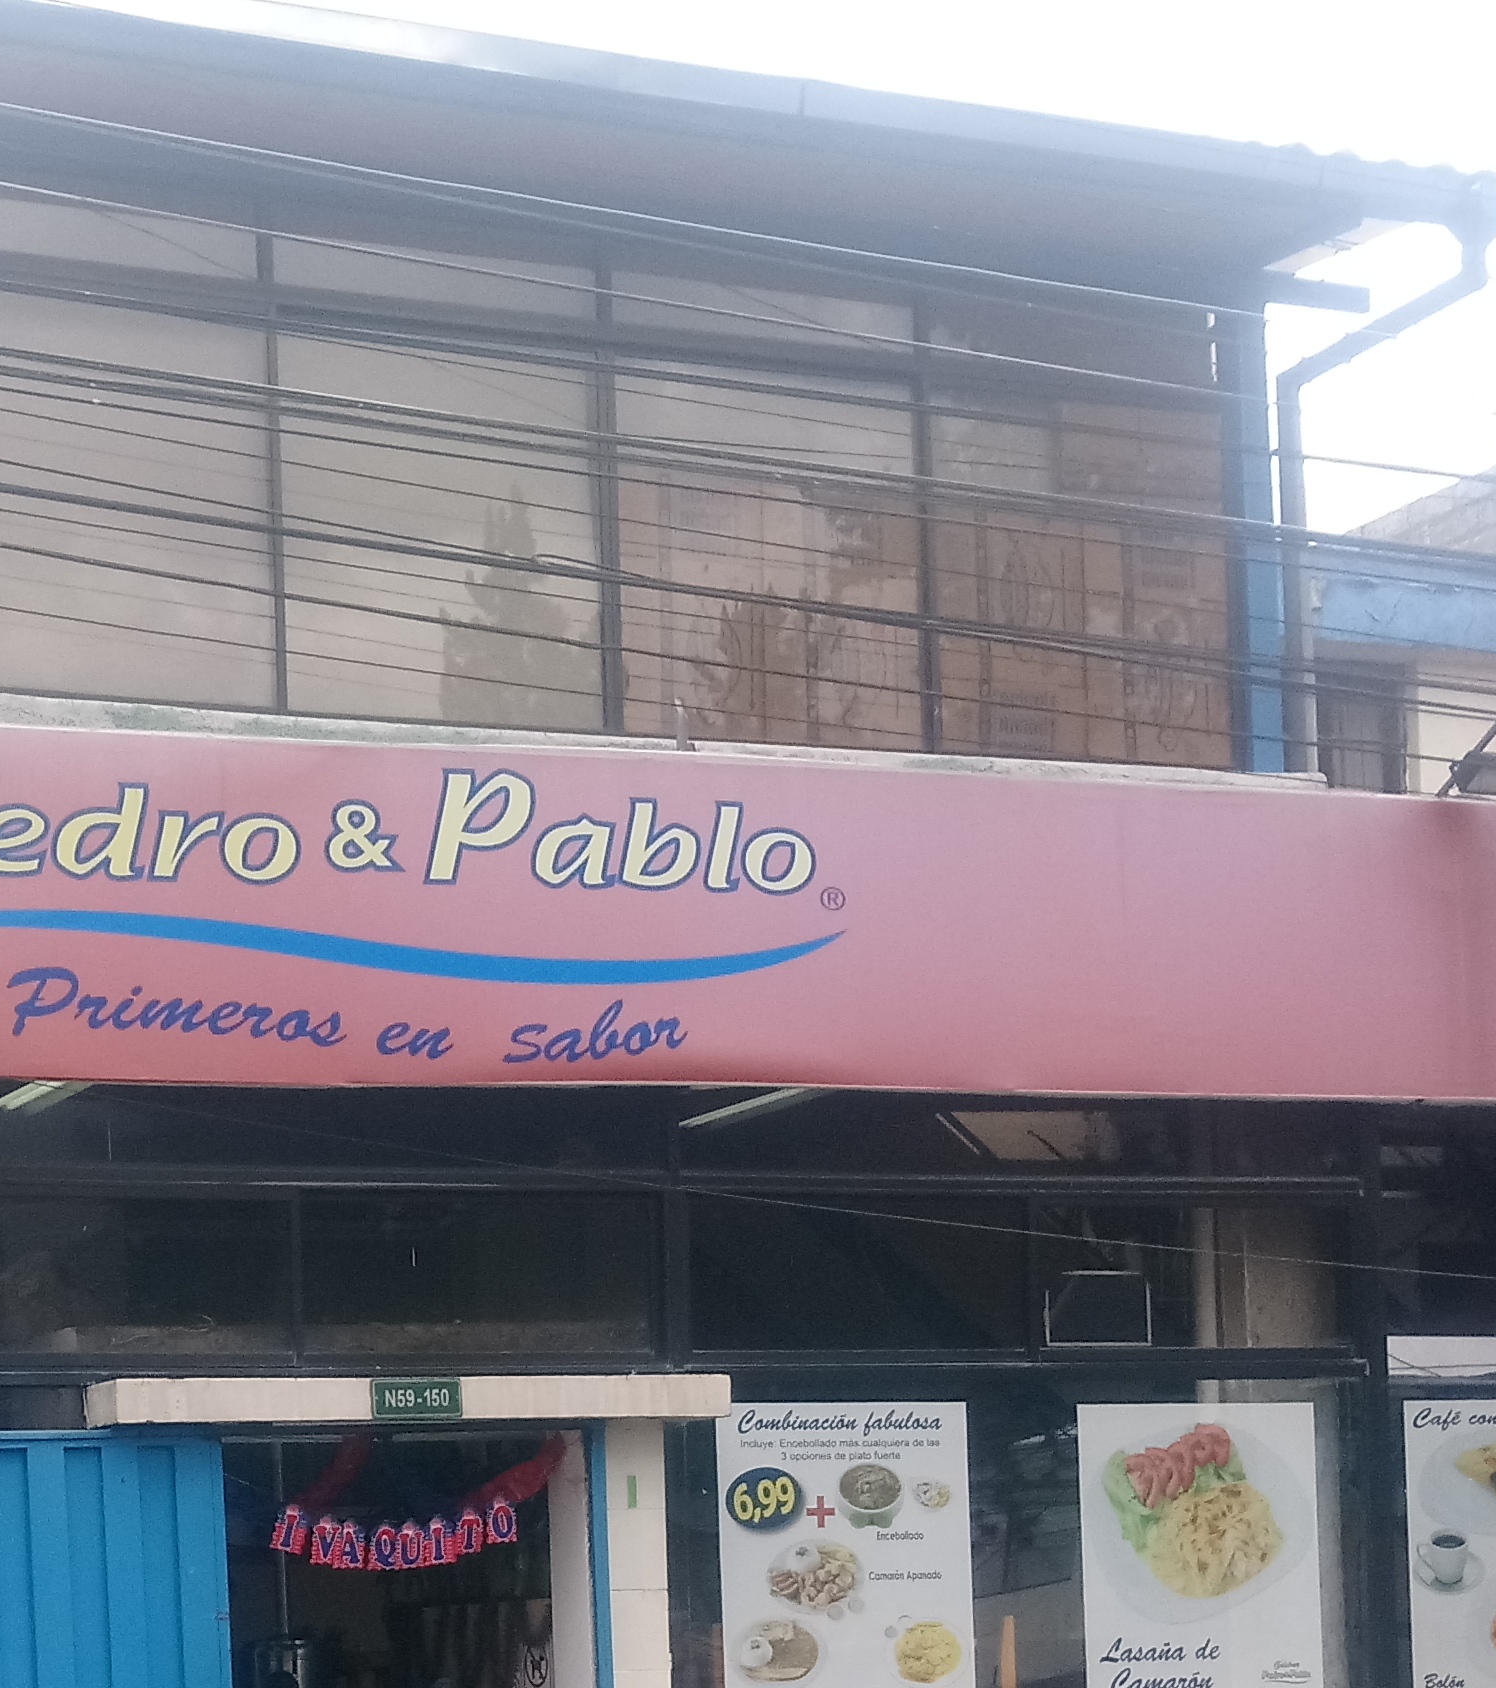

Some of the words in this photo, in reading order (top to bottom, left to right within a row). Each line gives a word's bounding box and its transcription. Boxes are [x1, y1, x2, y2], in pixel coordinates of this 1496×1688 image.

[324, 798, 406, 873] &
[424, 767, 816, 898] Pablo
[6, 965, 347, 1050] Primeros
[375, 1020, 454, 1060] en
[504, 998, 688, 1065] sabor
[384, 1388, 451, 1410] N59-150
[737, 1409, 858, 1435] Combinación
[863, 1411, 943, 1438] fabulosa
[1412, 1407, 1461, 1431] Café
[779, 1438, 837, 1448] Encebollado
[862, 1438, 910, 1449] cualquiera
[912, 1438, 925, 1447] de
[926, 1438, 941, 1447] las
[781, 1451, 788, 1461] 3
[789, 1451, 832, 1461] opciones
[834, 1451, 846, 1461] de
[848, 1451, 872, 1462] plato
[874, 1450, 901, 1460] fuerte
[733, 1476, 797, 1524] 6,99
[313, 1502, 519, 1571] VAQUITO
[1099, 1637, 1187, 1664] Lasaña
[1194, 1637, 1221, 1661] de
